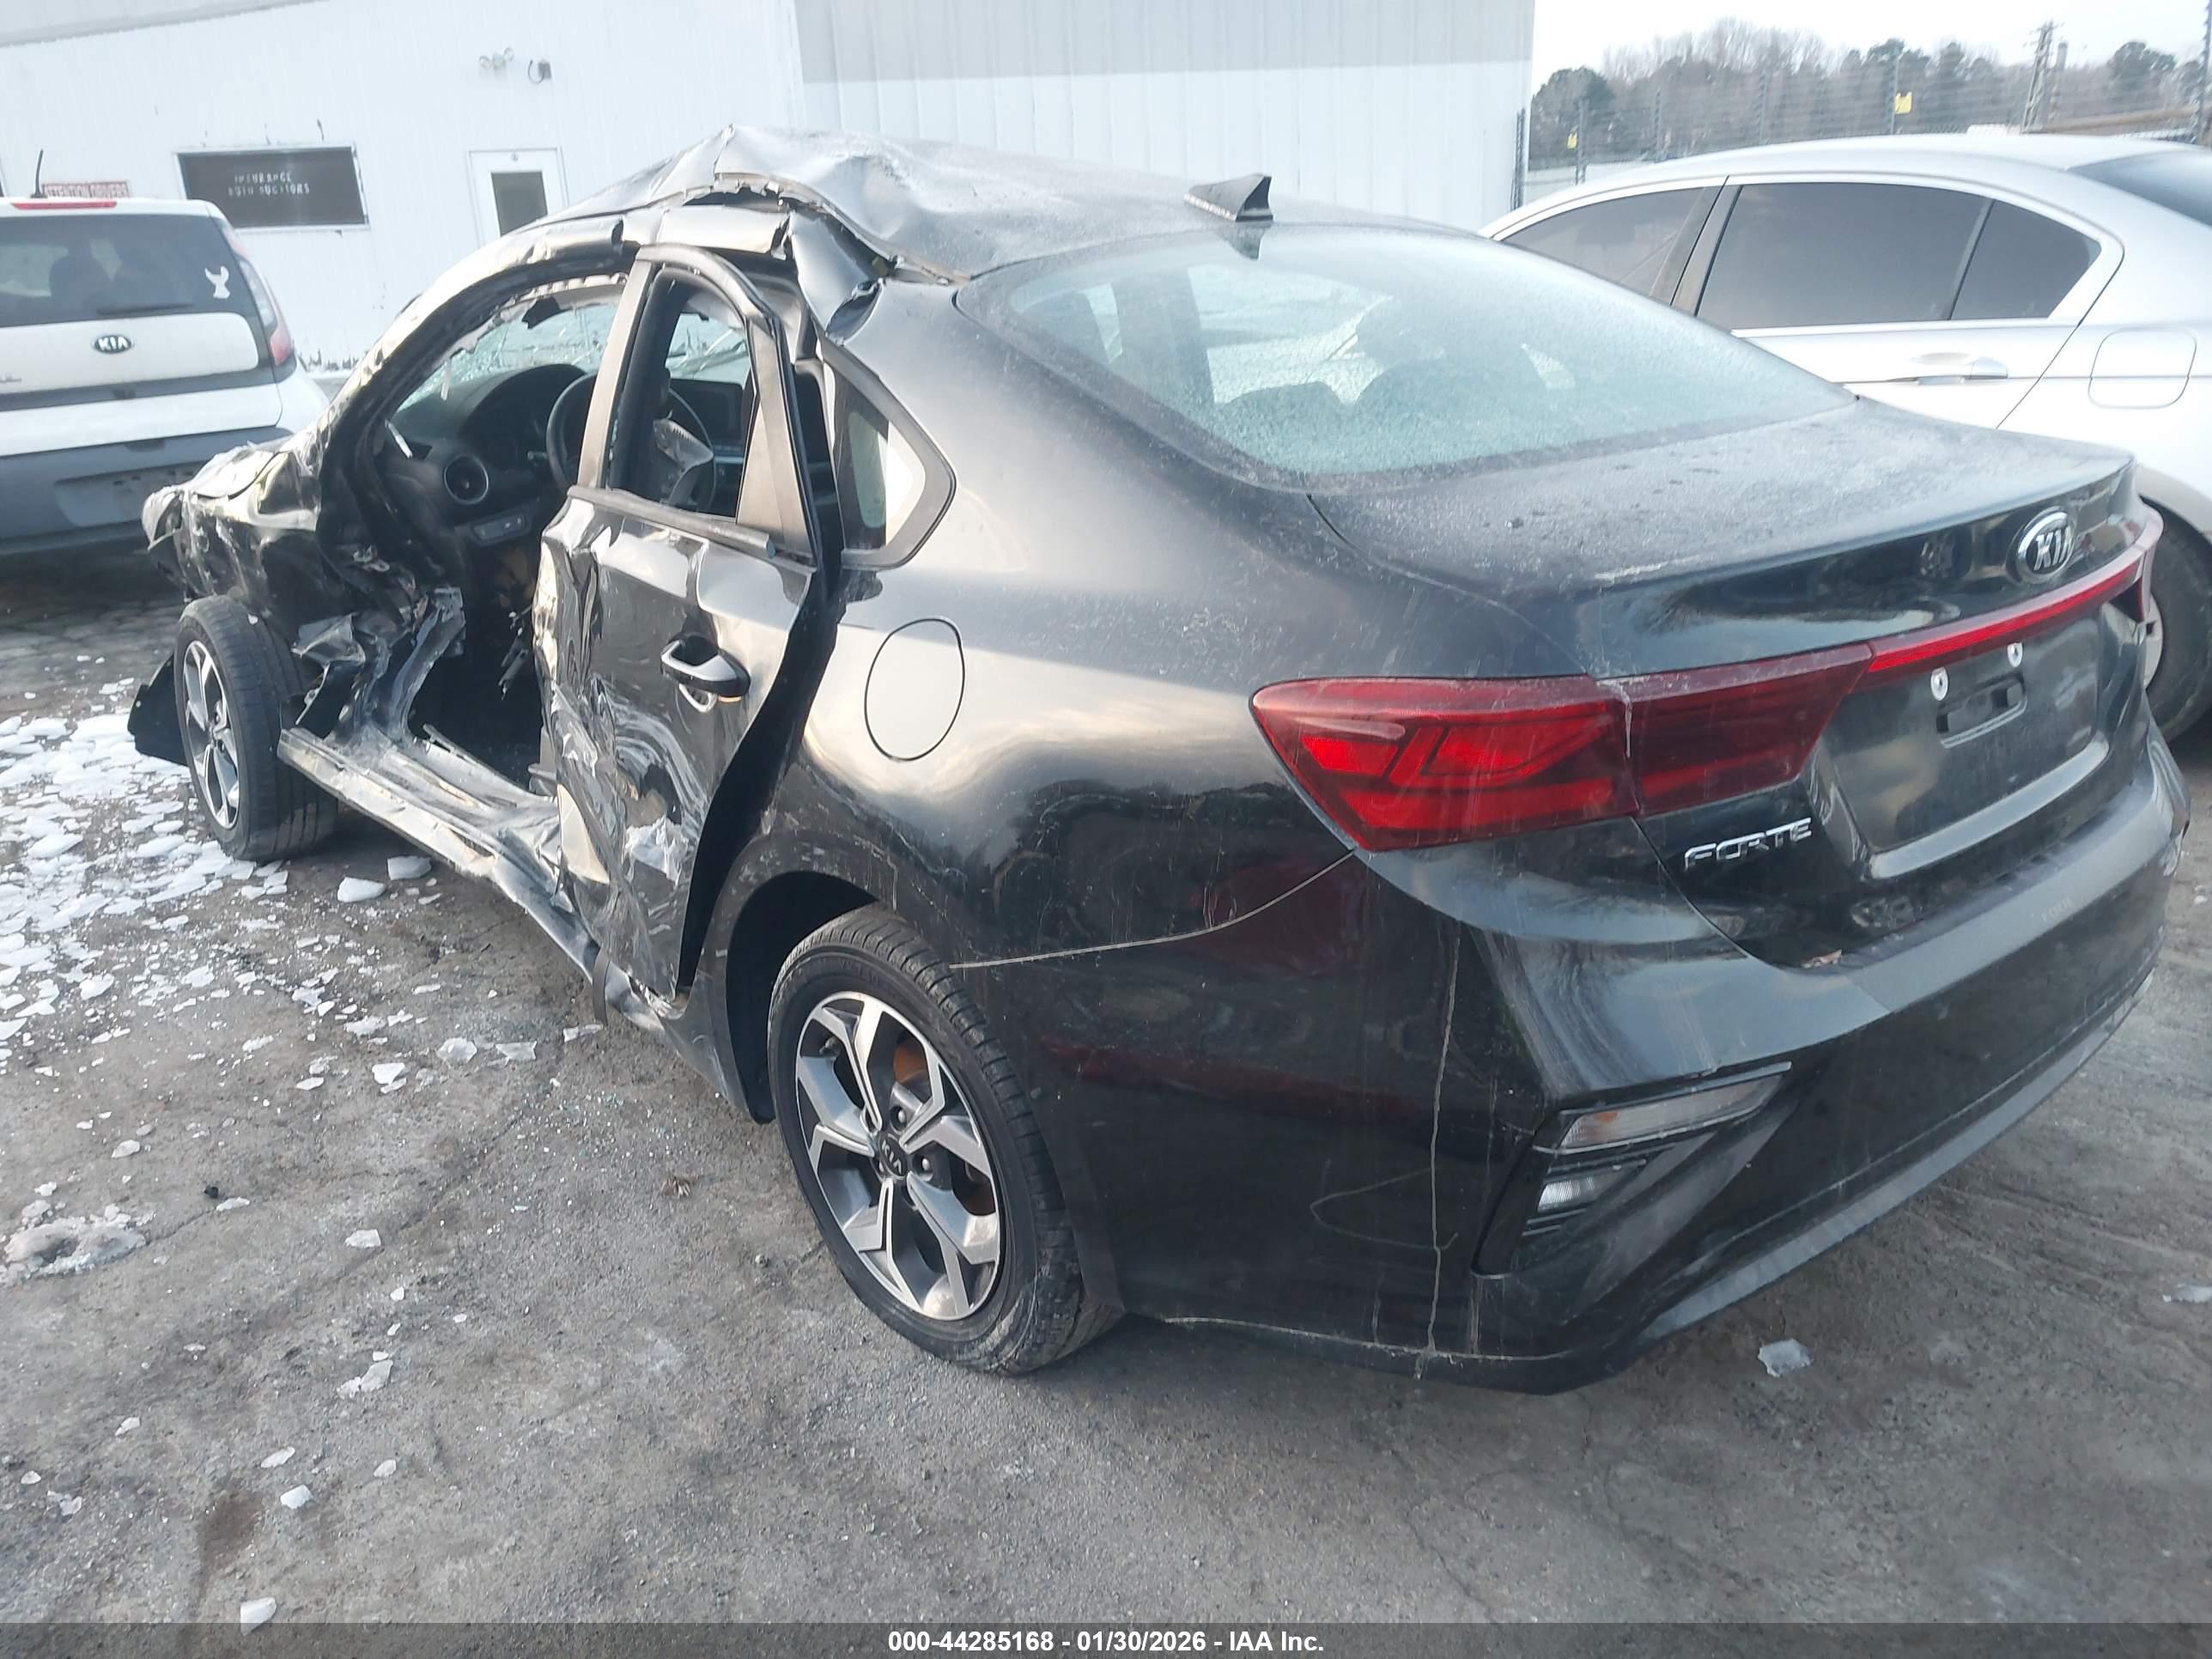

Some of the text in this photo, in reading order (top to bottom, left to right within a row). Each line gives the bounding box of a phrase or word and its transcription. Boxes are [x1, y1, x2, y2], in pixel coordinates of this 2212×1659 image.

[98, 336, 128, 351] KIA
[2033, 526, 2074, 572] KIA
[1683, 817, 1813, 872] FORTE
[881, 1138, 902, 1175] KIA
